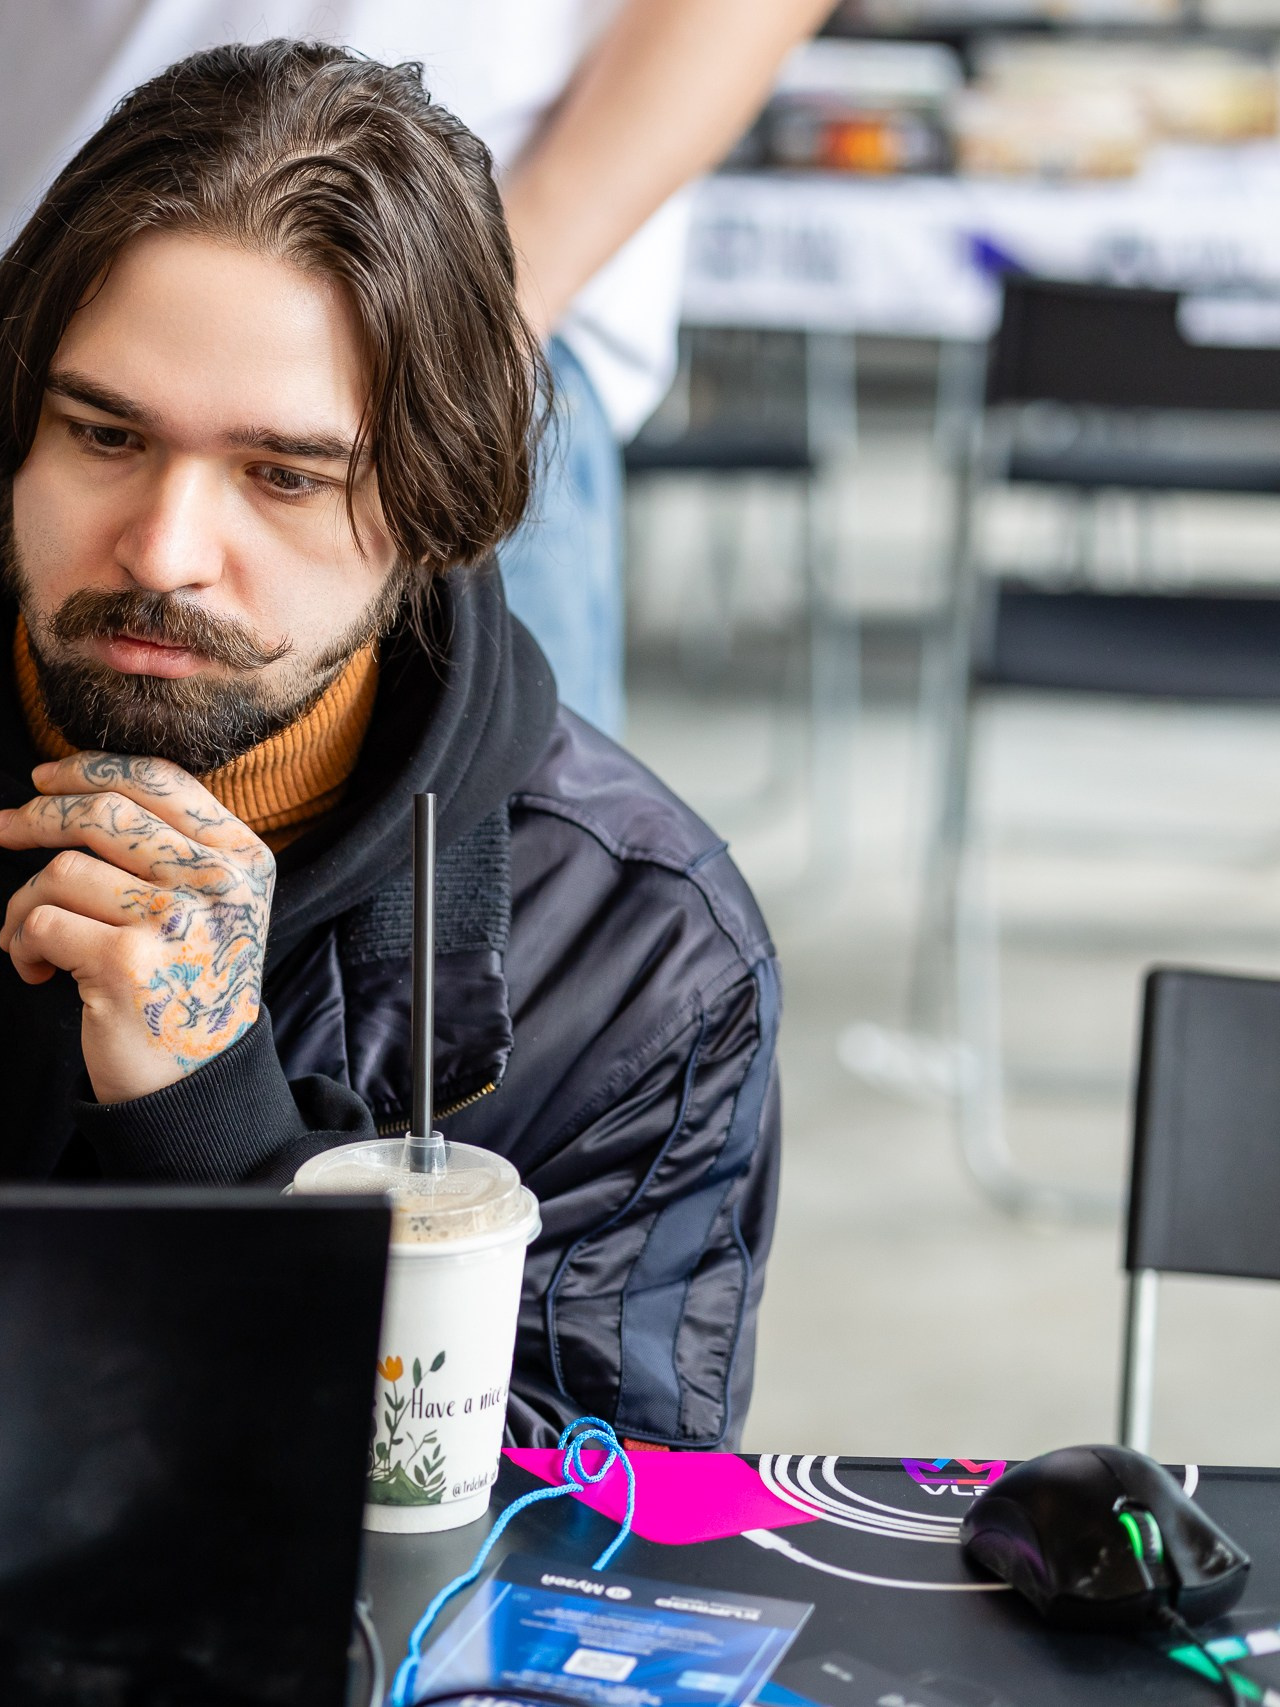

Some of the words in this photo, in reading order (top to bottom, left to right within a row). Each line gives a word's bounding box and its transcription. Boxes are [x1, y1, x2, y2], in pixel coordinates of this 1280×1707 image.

[411, 1387, 455, 1419] Have
[463, 1398, 473, 1414] a
[480, 1386, 502, 1411] nice
[540, 1573, 606, 1597] Музей
